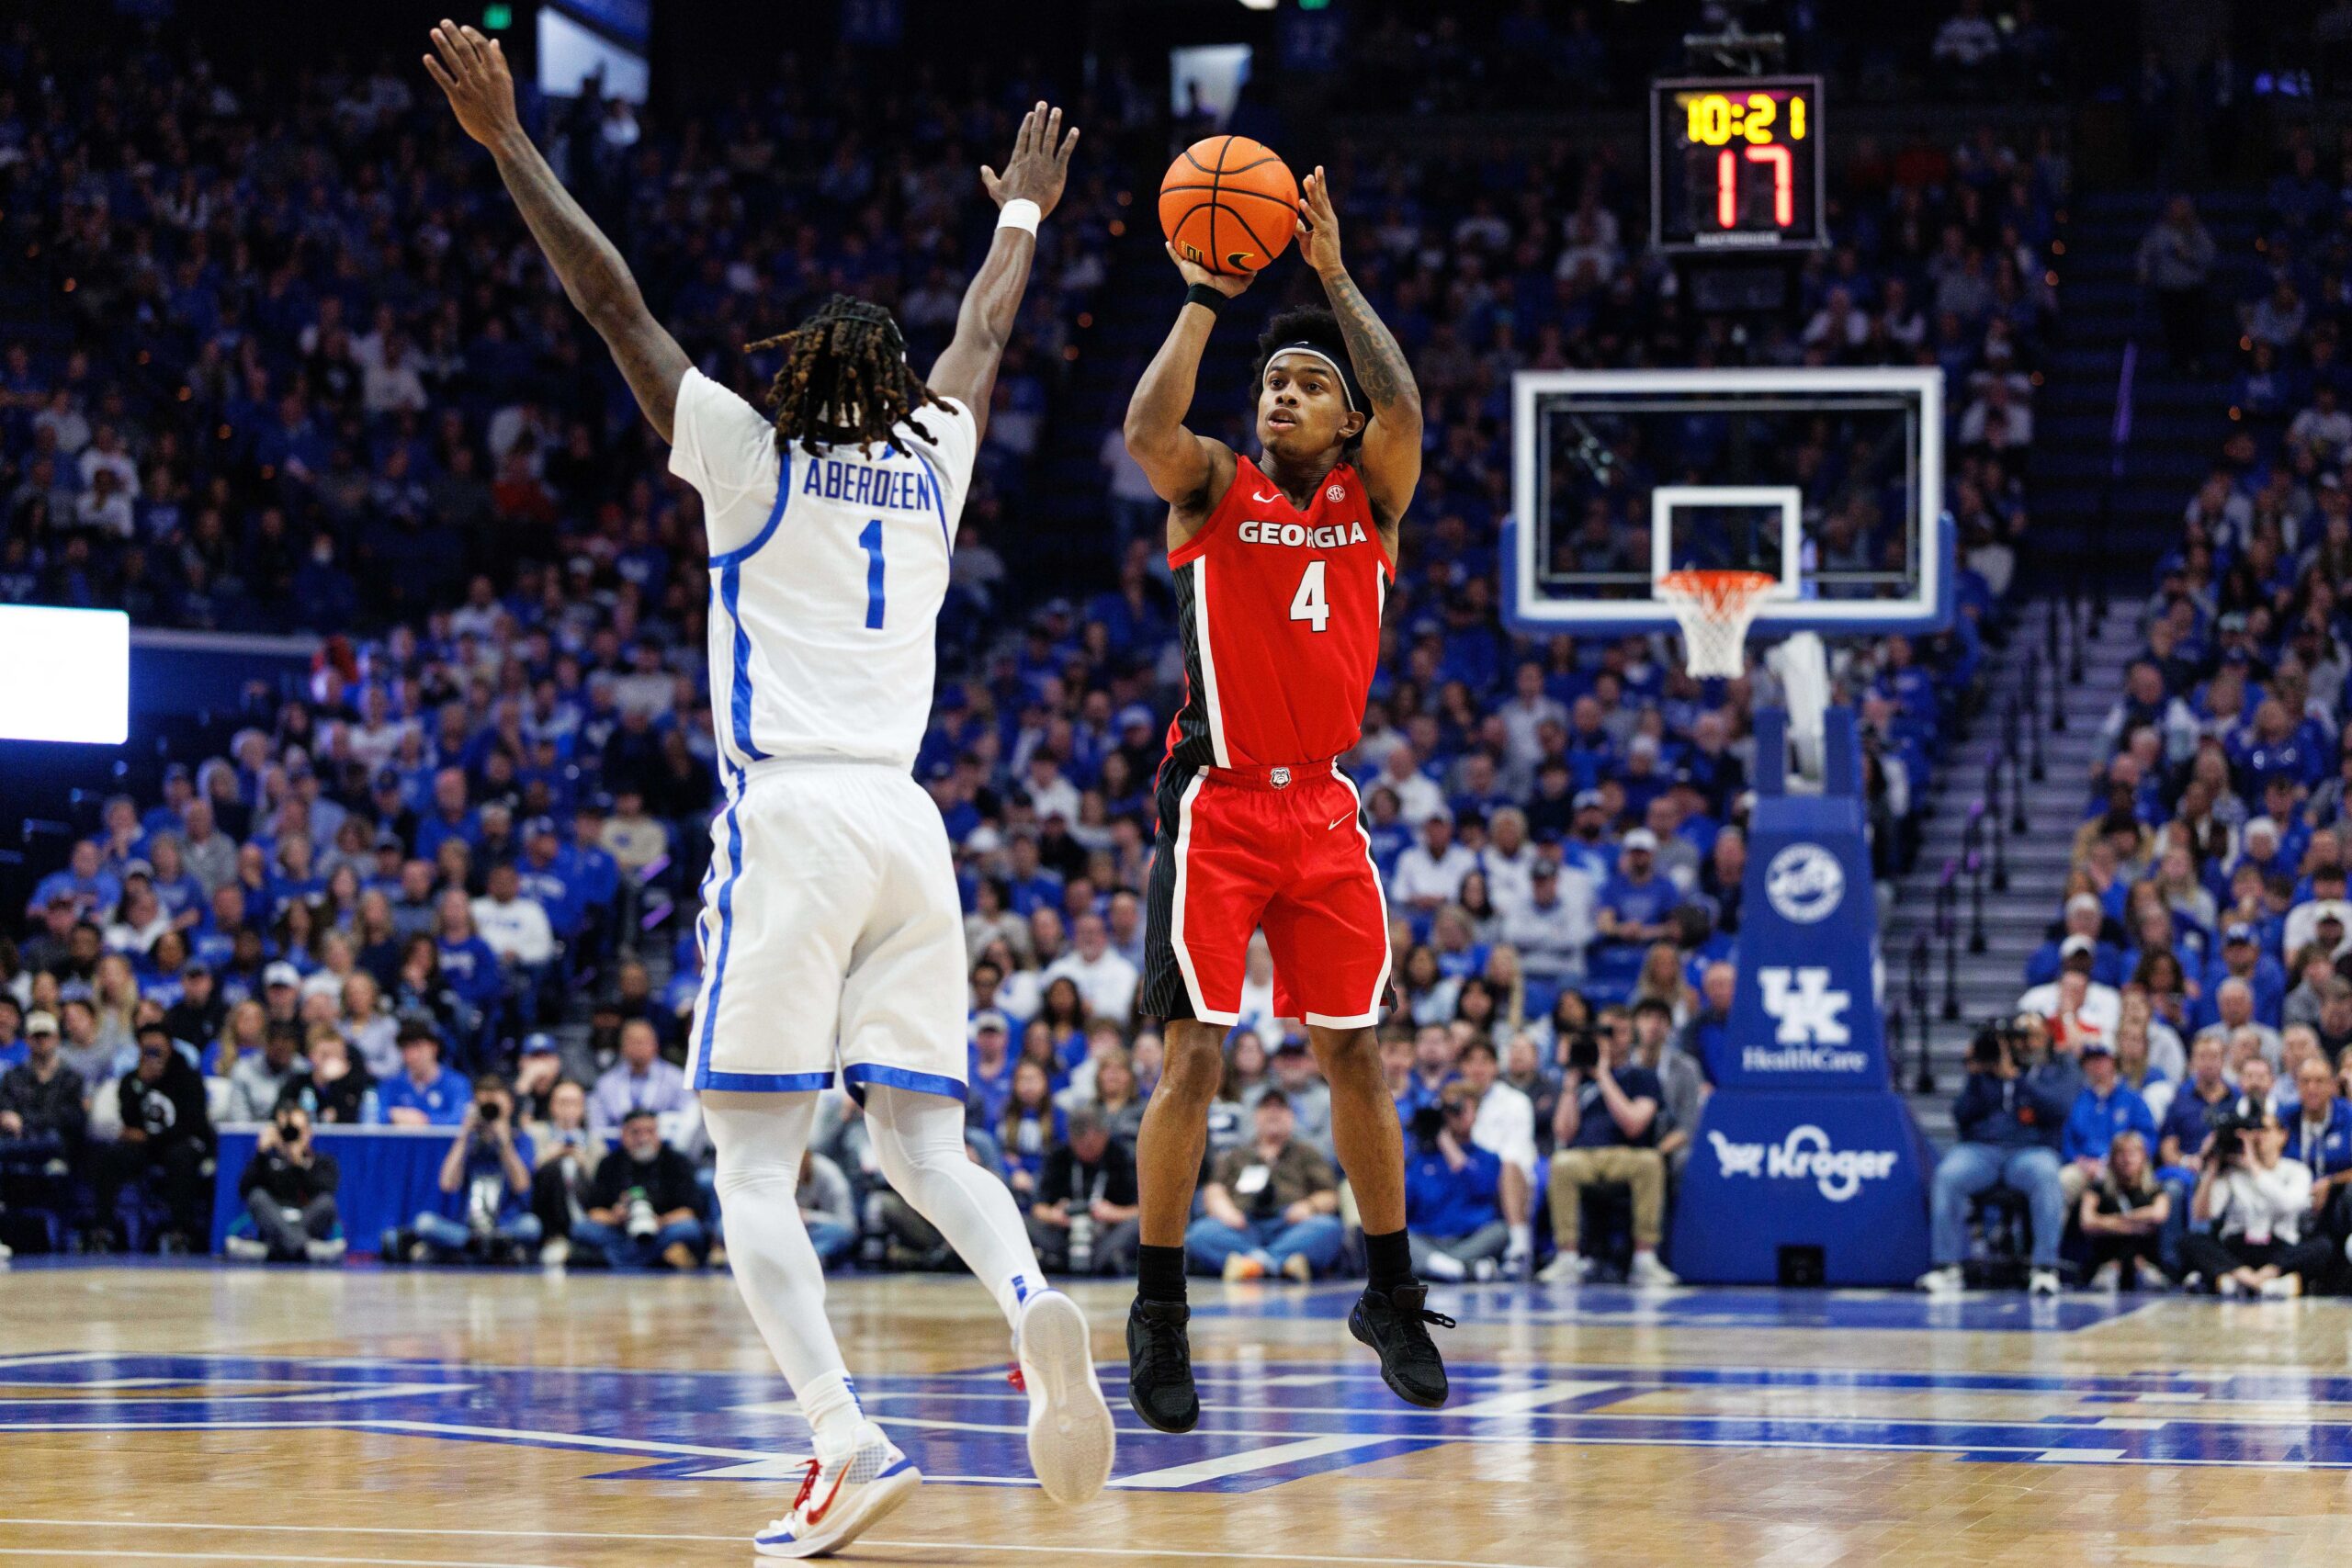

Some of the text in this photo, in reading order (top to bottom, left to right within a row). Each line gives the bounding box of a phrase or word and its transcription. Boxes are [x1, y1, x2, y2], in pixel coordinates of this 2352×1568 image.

[1688, 94, 1805, 146] 10:21
[1717, 143, 1792, 229] 17
[803, 458, 931, 511] ABERDEEN
[1328, 486, 1344, 501] SEC
[1238, 520, 1368, 548] GEORGIA
[858, 519, 886, 630] 1
[1289, 559, 1329, 632] 4
[1757, 966, 1851, 1044] UK
[1742, 1045, 1869, 1073] HealthCare
[1767, 1124, 1899, 1202] Kroger
